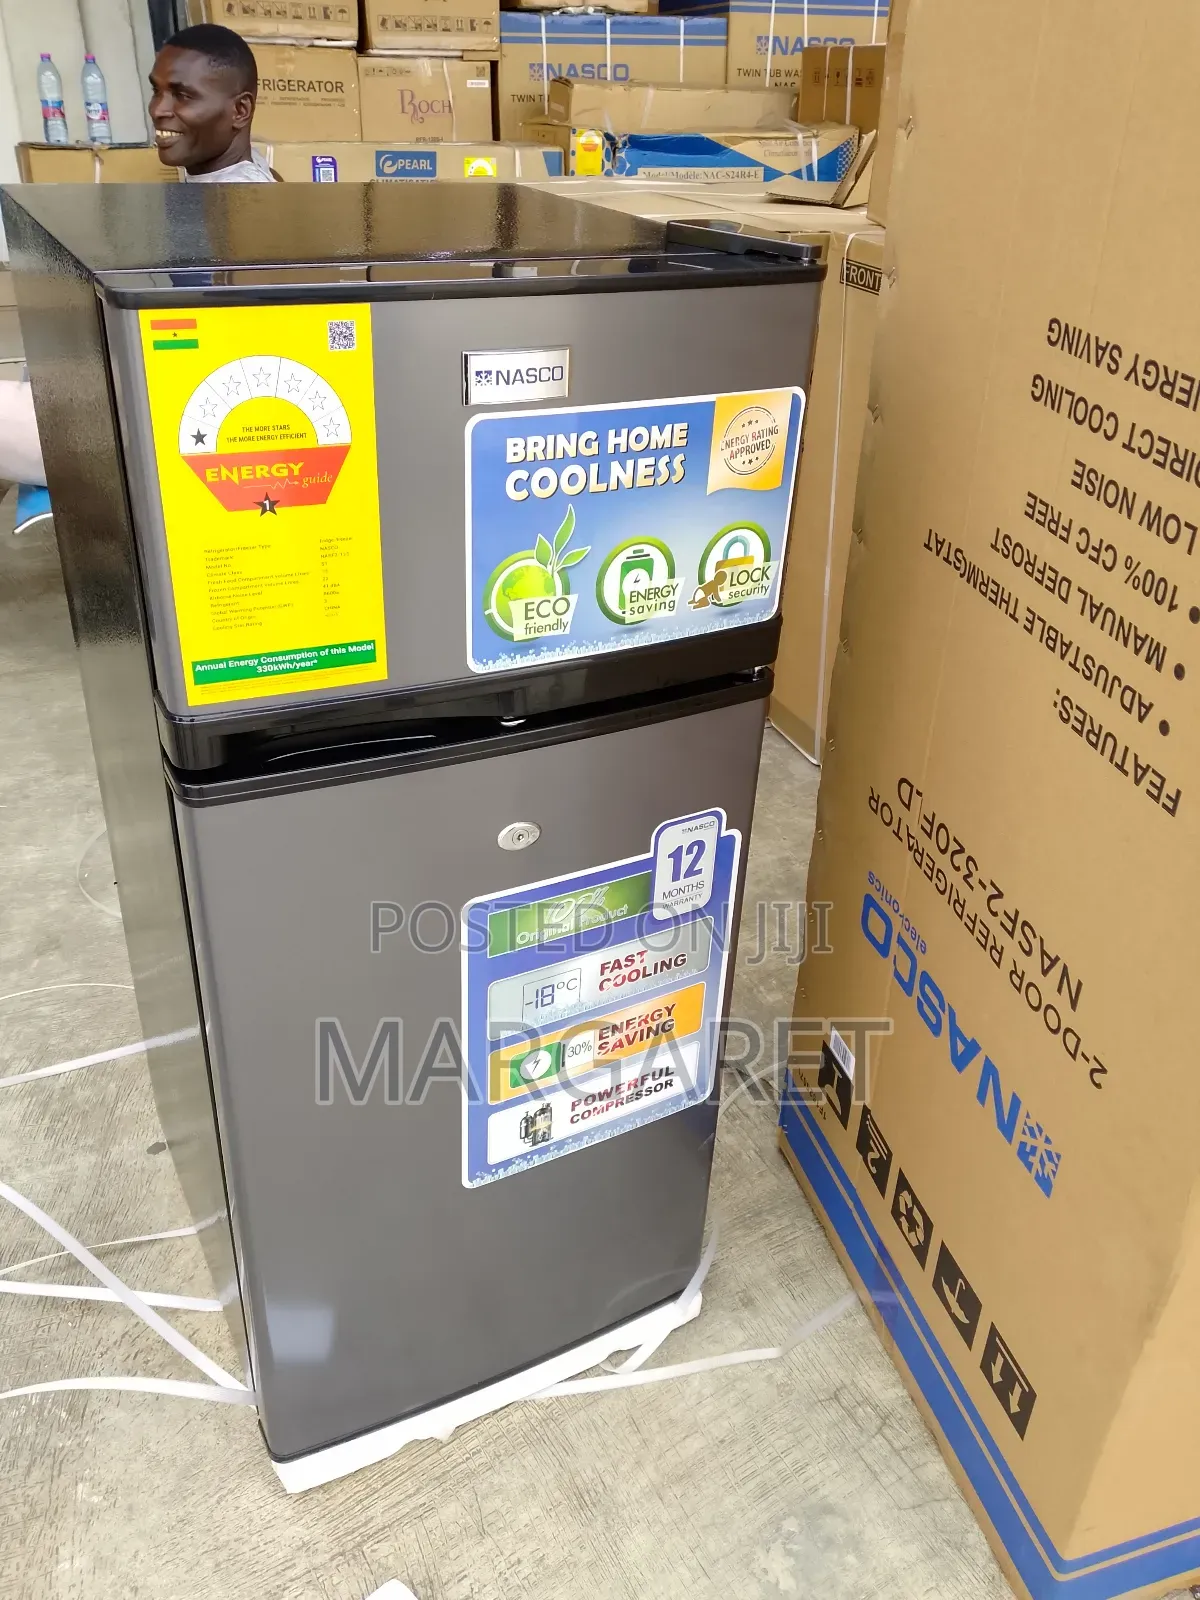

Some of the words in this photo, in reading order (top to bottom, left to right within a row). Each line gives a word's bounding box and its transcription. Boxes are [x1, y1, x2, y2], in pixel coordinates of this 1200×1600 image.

[546, 63, 629, 82] NASCO
[737, 68, 760, 78] TWIN
[511, 94, 535, 103] TWIN
[397, 159, 433, 171] PEARL
[1046, 317, 1123, 376] SAVING
[495, 365, 564, 386] NASCO
[1031, 373, 1119, 442] COOLING
[238, 435, 255, 443] MORE
[256, 434, 278, 442] ENERGY
[279, 432, 307, 440] EFFICIENT
[505, 429, 599, 463] BRING
[607, 422, 689, 454] HOME
[729, 438, 771, 461] APPROVED
[751, 425, 779, 442] RATING
[205, 461, 305, 485] ENERGY
[302, 471, 333, 488] guide
[505, 453, 687, 502] COOLNESS
[1070, 458, 1137, 520] NOISE
[1024, 490, 1073, 545] FREE
[1138, 500, 1199, 556] LOW
[990, 527, 1072, 605] DEFROST
[1075, 526, 1118, 572] CFC
[629, 583, 680, 604] ENERGY
[728, 583, 771, 600] security
[729, 564, 772, 587] LOCK
[1124, 555, 1179, 613] 100%
[523, 596, 571, 621] ECO
[629, 599, 676, 616] saving
[523, 620, 569, 636] friendly
[1077, 586, 1168, 673] MANUAL
[195, 661, 227, 672] Annual
[228, 657, 259, 669] Energy
[260, 651, 319, 664] Consumption
[320, 647, 330, 656] of
[331, 646, 347, 655] this
[348, 643, 374, 653] Model
[1022, 606, 1154, 724] ADJUSTABLE
[1052, 687, 1183, 818] FEATURES:
[686, 820, 716, 833] NASCO
[667, 838, 707, 883] 12
[868, 785, 1005, 969] REFRIGERATOR
[662, 880, 705, 900] MONTHS
[662, 892, 703, 909] WARRANTY
[516, 918, 575, 945] Original
[579, 903, 629, 928] Product
[598, 953, 688, 992] COOLING
[600, 949, 649, 977] FAST
[597, 1018, 676, 1056] SAVING
[598, 1002, 676, 1042] ENERGY
[860, 892, 1023, 1146] NASCO
[1008, 958, 1109, 1090] 2-DOOR
[567, 1039, 593, 1058] 30%
[569, 1078, 674, 1125] COMPRESSOR
[570, 1065, 675, 1112] POWERFUL
